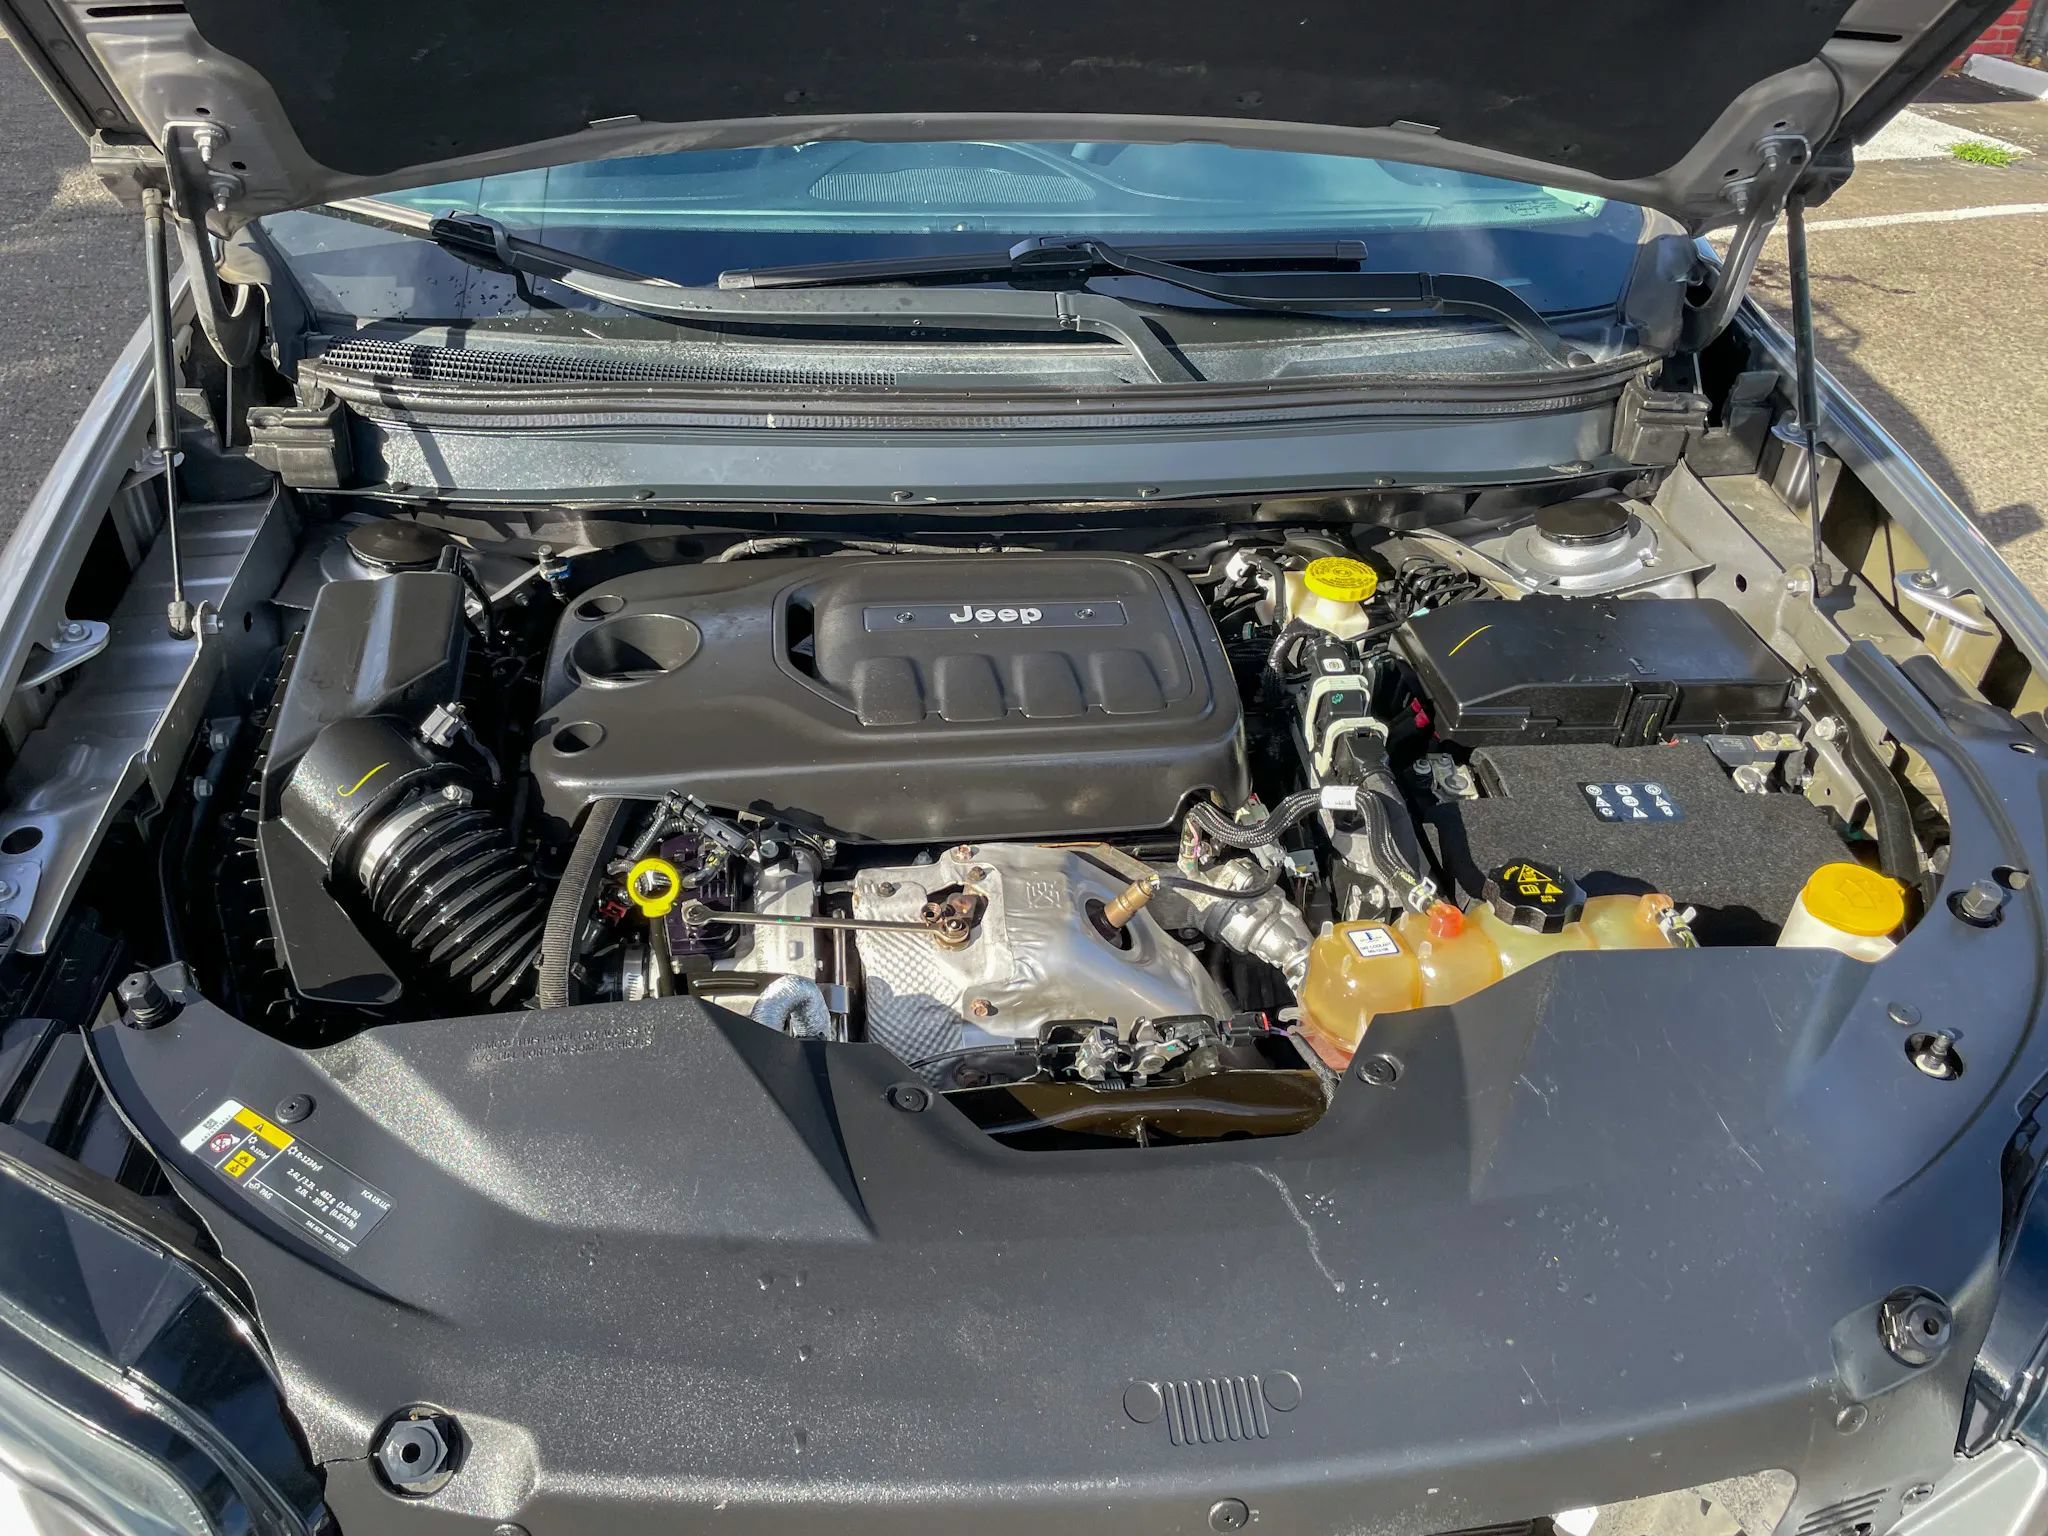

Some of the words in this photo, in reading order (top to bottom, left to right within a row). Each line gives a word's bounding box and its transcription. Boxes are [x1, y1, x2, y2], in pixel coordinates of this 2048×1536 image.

[950, 605, 1043, 624] Jeep
[517, 1036, 540, 1046] THIS
[543, 1032, 574, 1043] PANEL
[522, 1048, 549, 1058] PORT
[259, 1188, 274, 1200] PAG
[360, 1189, 373, 1200] FCA
[371, 1195, 381, 1204] US
[378, 1200, 391, 1210] LLC
